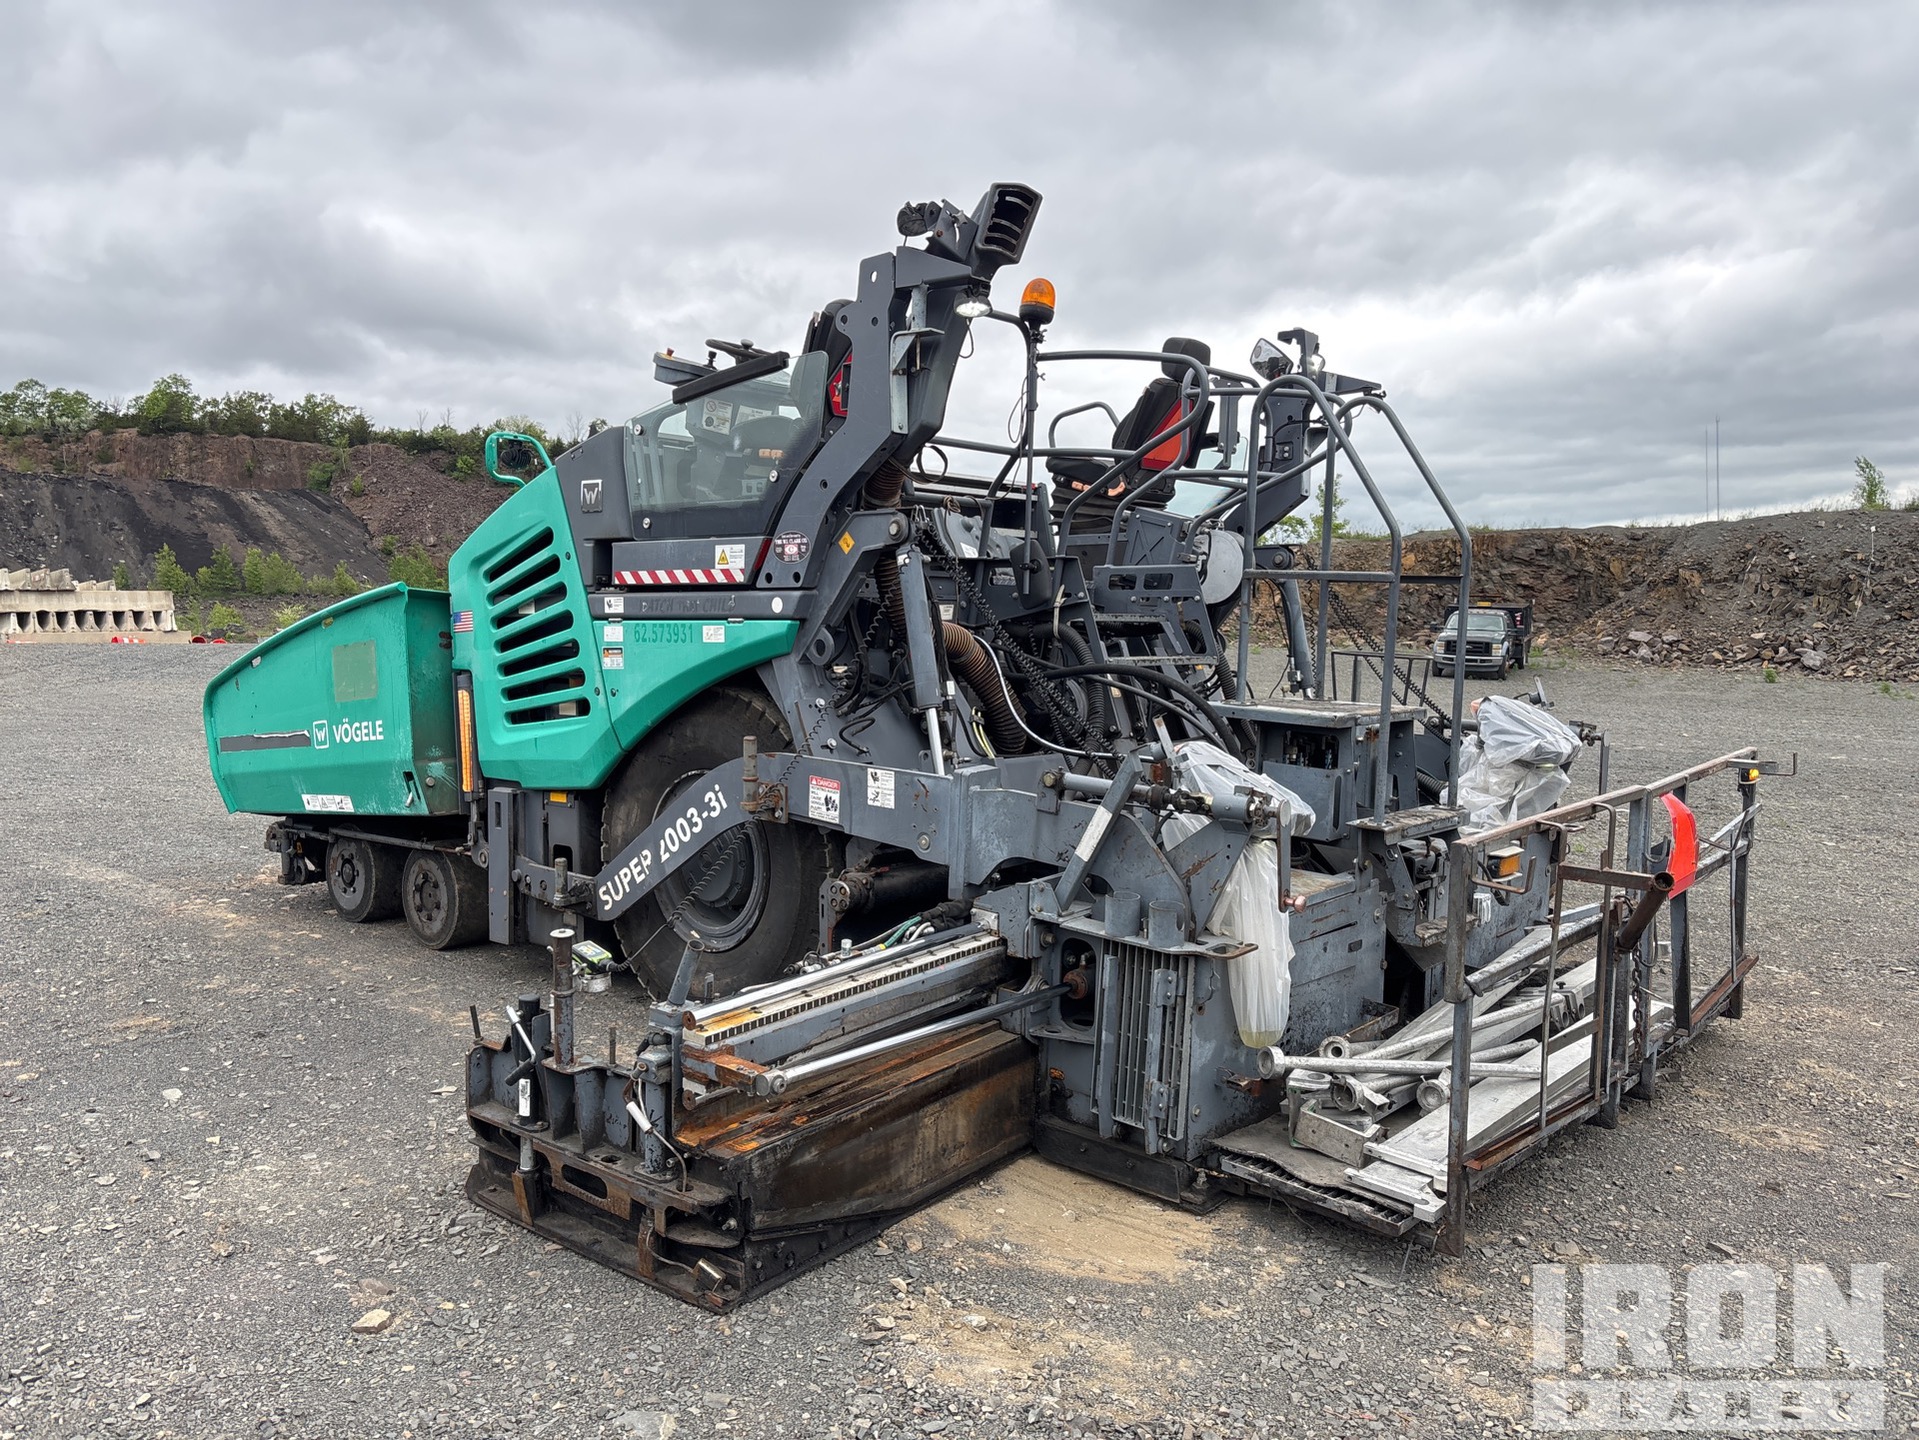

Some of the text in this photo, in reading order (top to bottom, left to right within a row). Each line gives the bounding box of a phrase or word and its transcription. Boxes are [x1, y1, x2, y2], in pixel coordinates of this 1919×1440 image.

[634, 623, 693, 643] 62.573931
[332, 717, 384, 743] VÖGELE
[816, 778, 838, 789] DANGER
